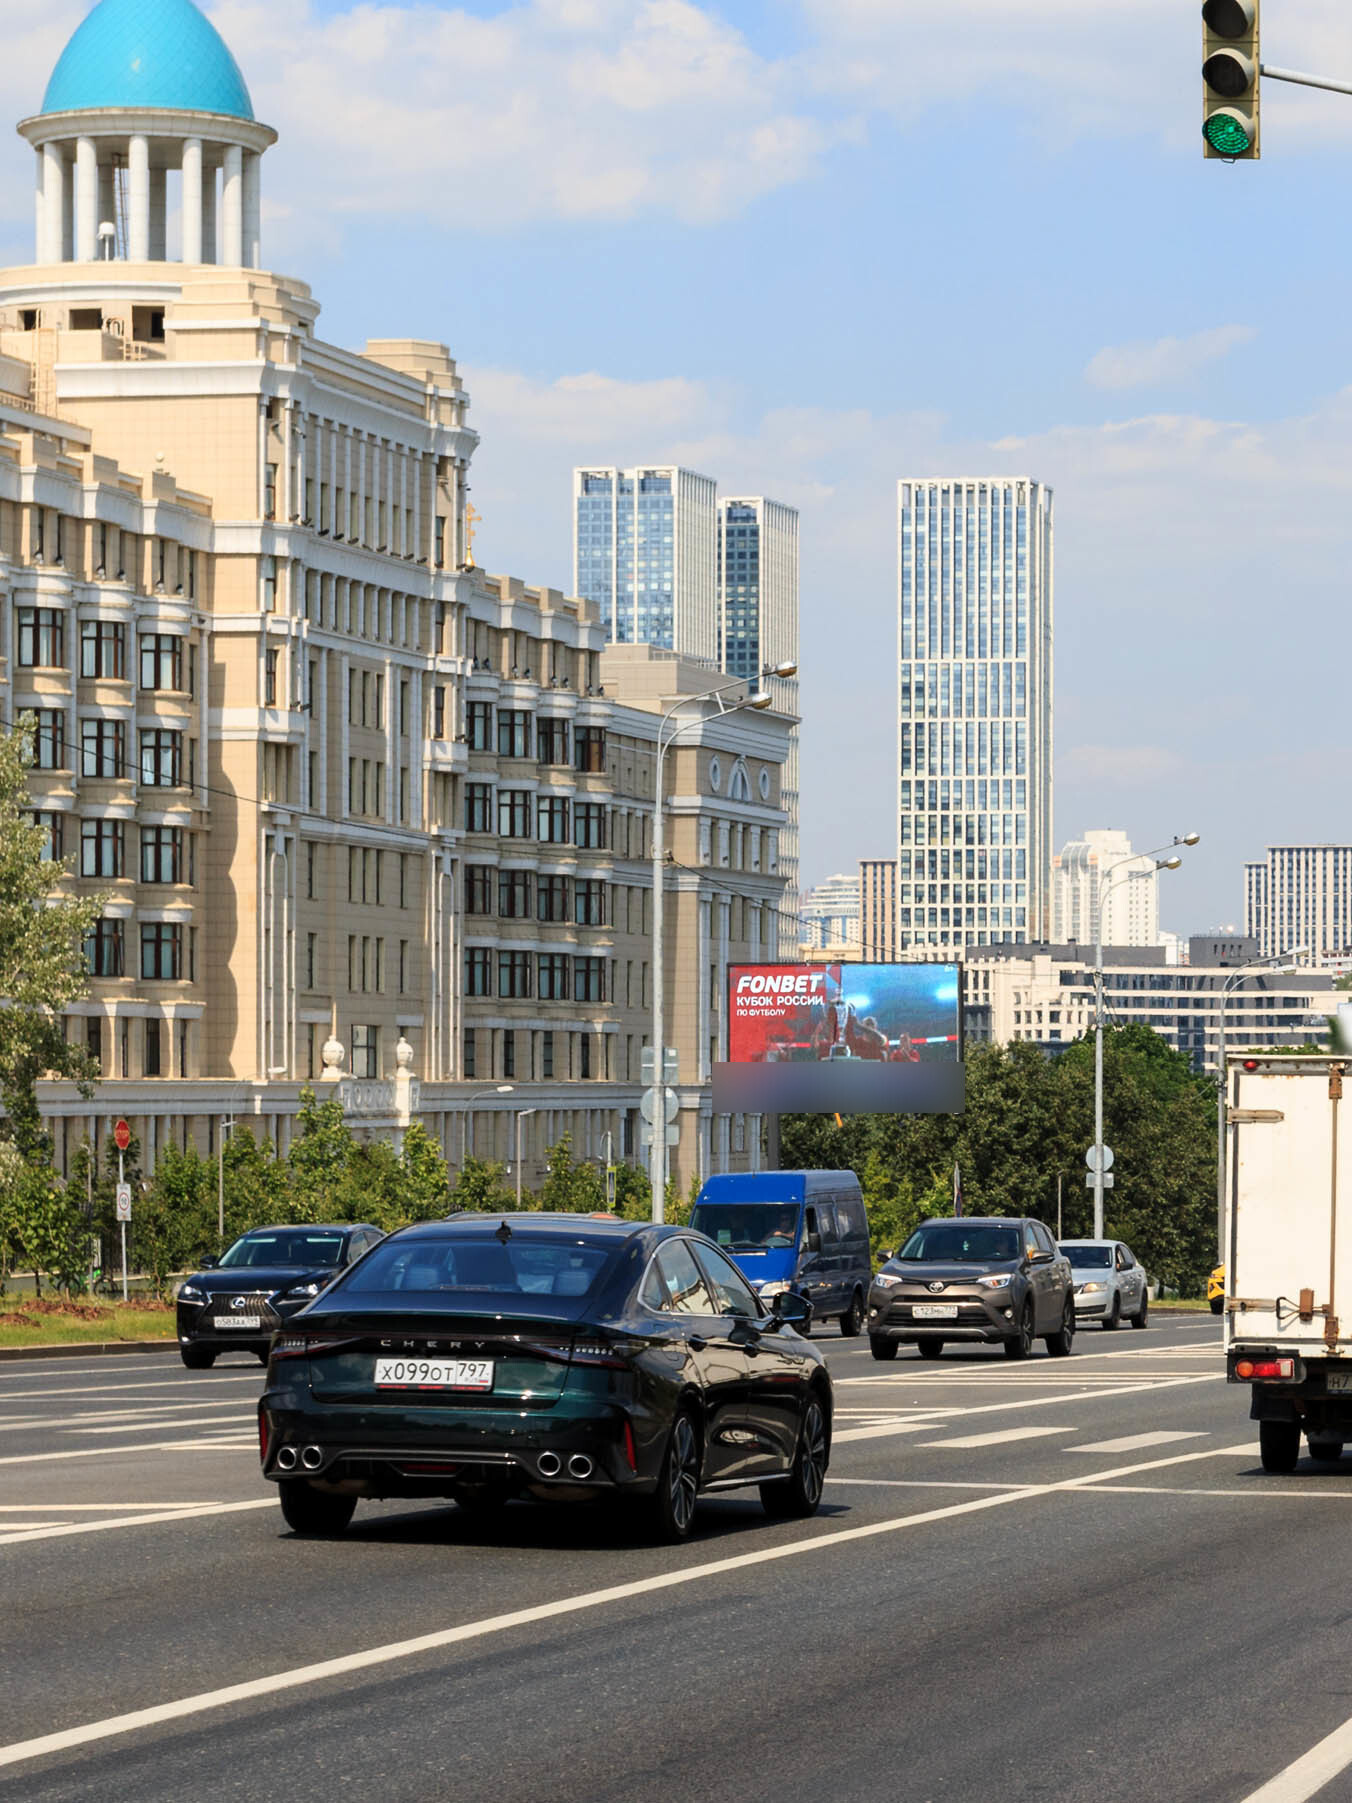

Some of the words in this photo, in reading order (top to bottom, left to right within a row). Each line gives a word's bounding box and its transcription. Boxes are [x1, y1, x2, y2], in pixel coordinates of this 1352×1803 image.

[736, 975, 823, 994] FONBET
[736, 996, 773, 1006] КУБОК
[776, 995, 823, 1006] РОССИИ
[749, 1008, 786, 1016] ФУТБОЛУ
